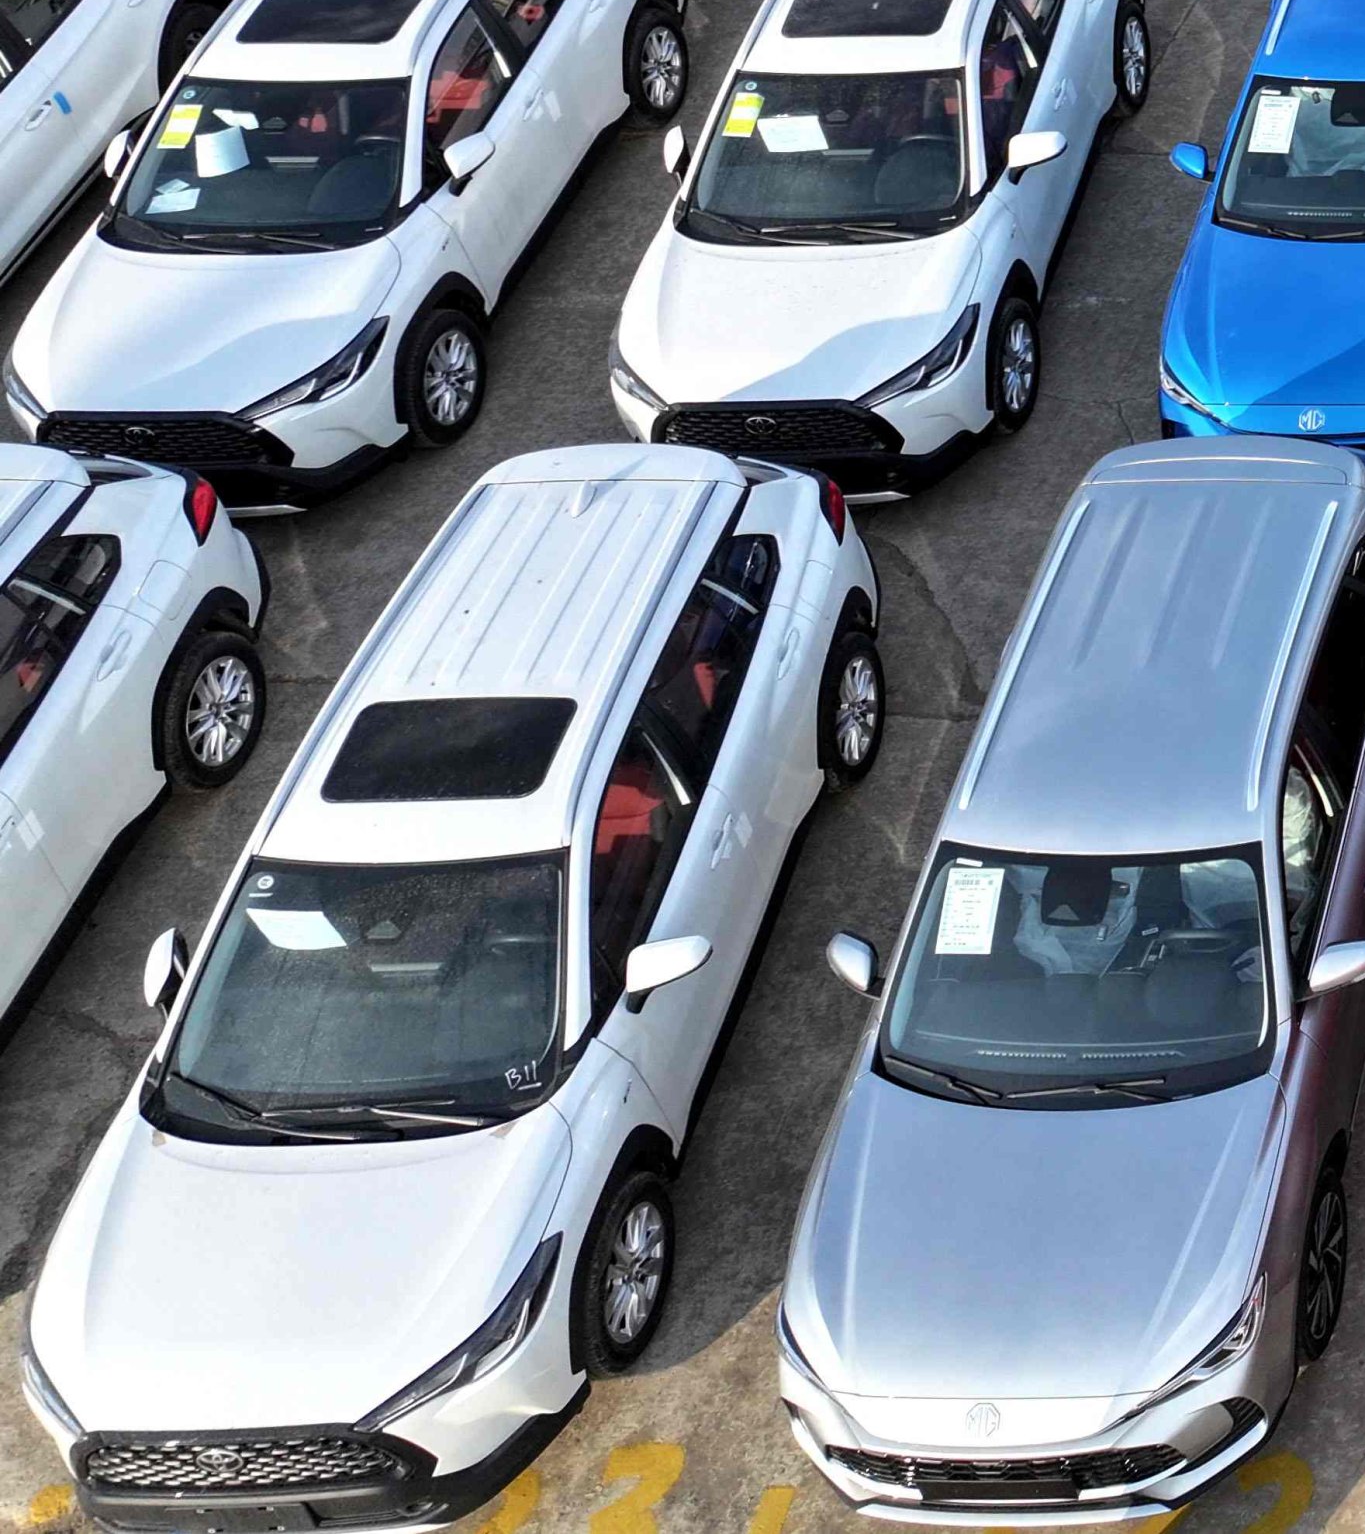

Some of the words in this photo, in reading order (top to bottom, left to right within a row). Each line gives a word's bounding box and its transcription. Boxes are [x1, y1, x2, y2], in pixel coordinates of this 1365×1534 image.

[1301, 409, 1324, 430] MG
[504, 1060, 538, 1090] B11
[968, 1406, 998, 1437] MG
